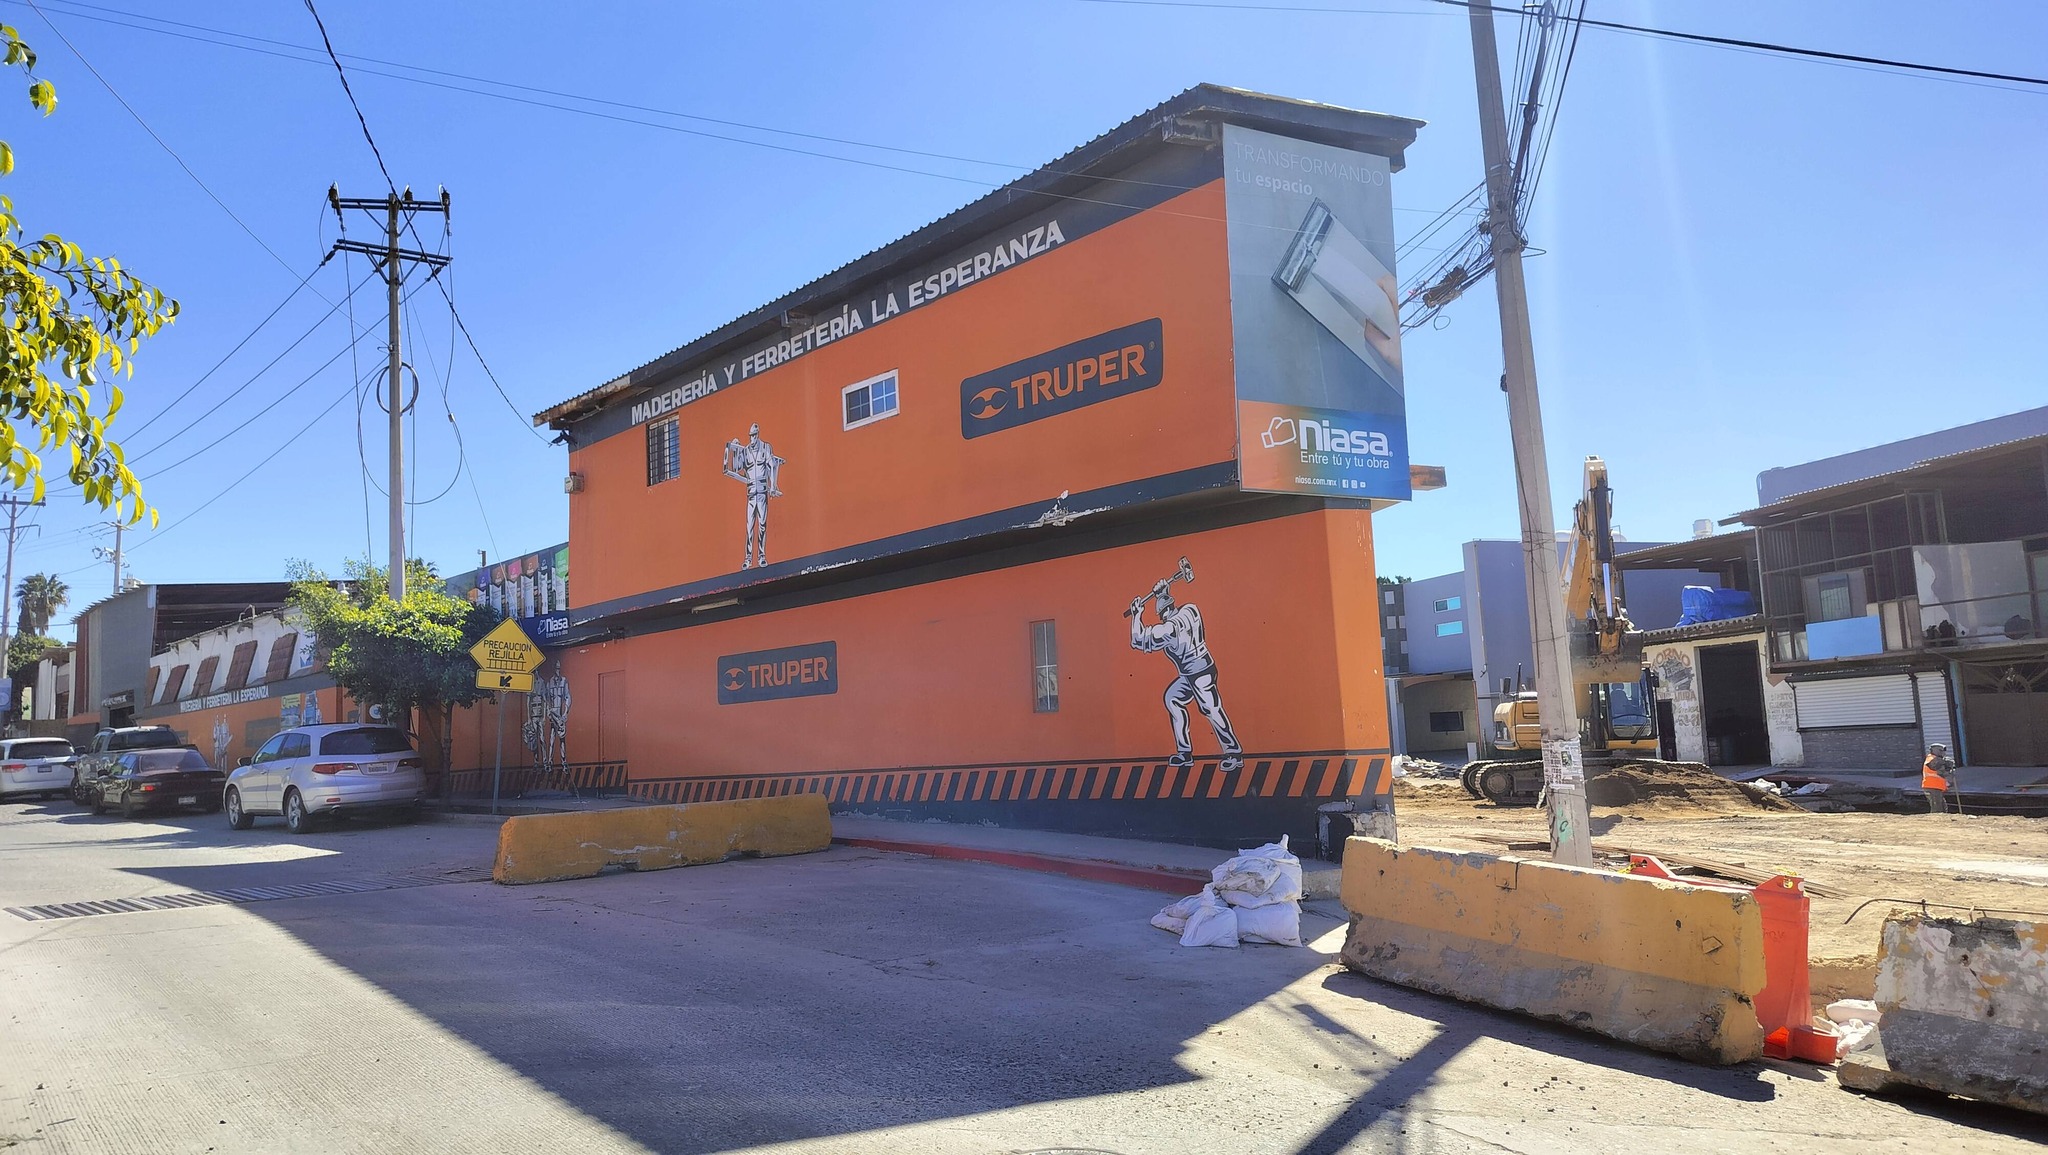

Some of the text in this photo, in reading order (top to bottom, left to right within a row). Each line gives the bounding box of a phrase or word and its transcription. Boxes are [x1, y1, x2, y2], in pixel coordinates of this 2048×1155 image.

[1234, 142, 1384, 187] TRANSFORMANDO
[1234, 167, 1313, 196] tu espacio
[631, 219, 1066, 426] MADERERÍA Y FERRETERÍA LA ESPERANZA
[1010, 344, 1148, 410] TRUPER
[1300, 450, 1390, 469] Entre tú y tu obra
[483, 639, 532, 653] PRECAUCION
[488, 649, 525, 661] REJILLA
[747, 656, 829, 689] TRUPER
[233, 691, 241, 704] LA
[240, 685, 270, 703] ESPERANZA
